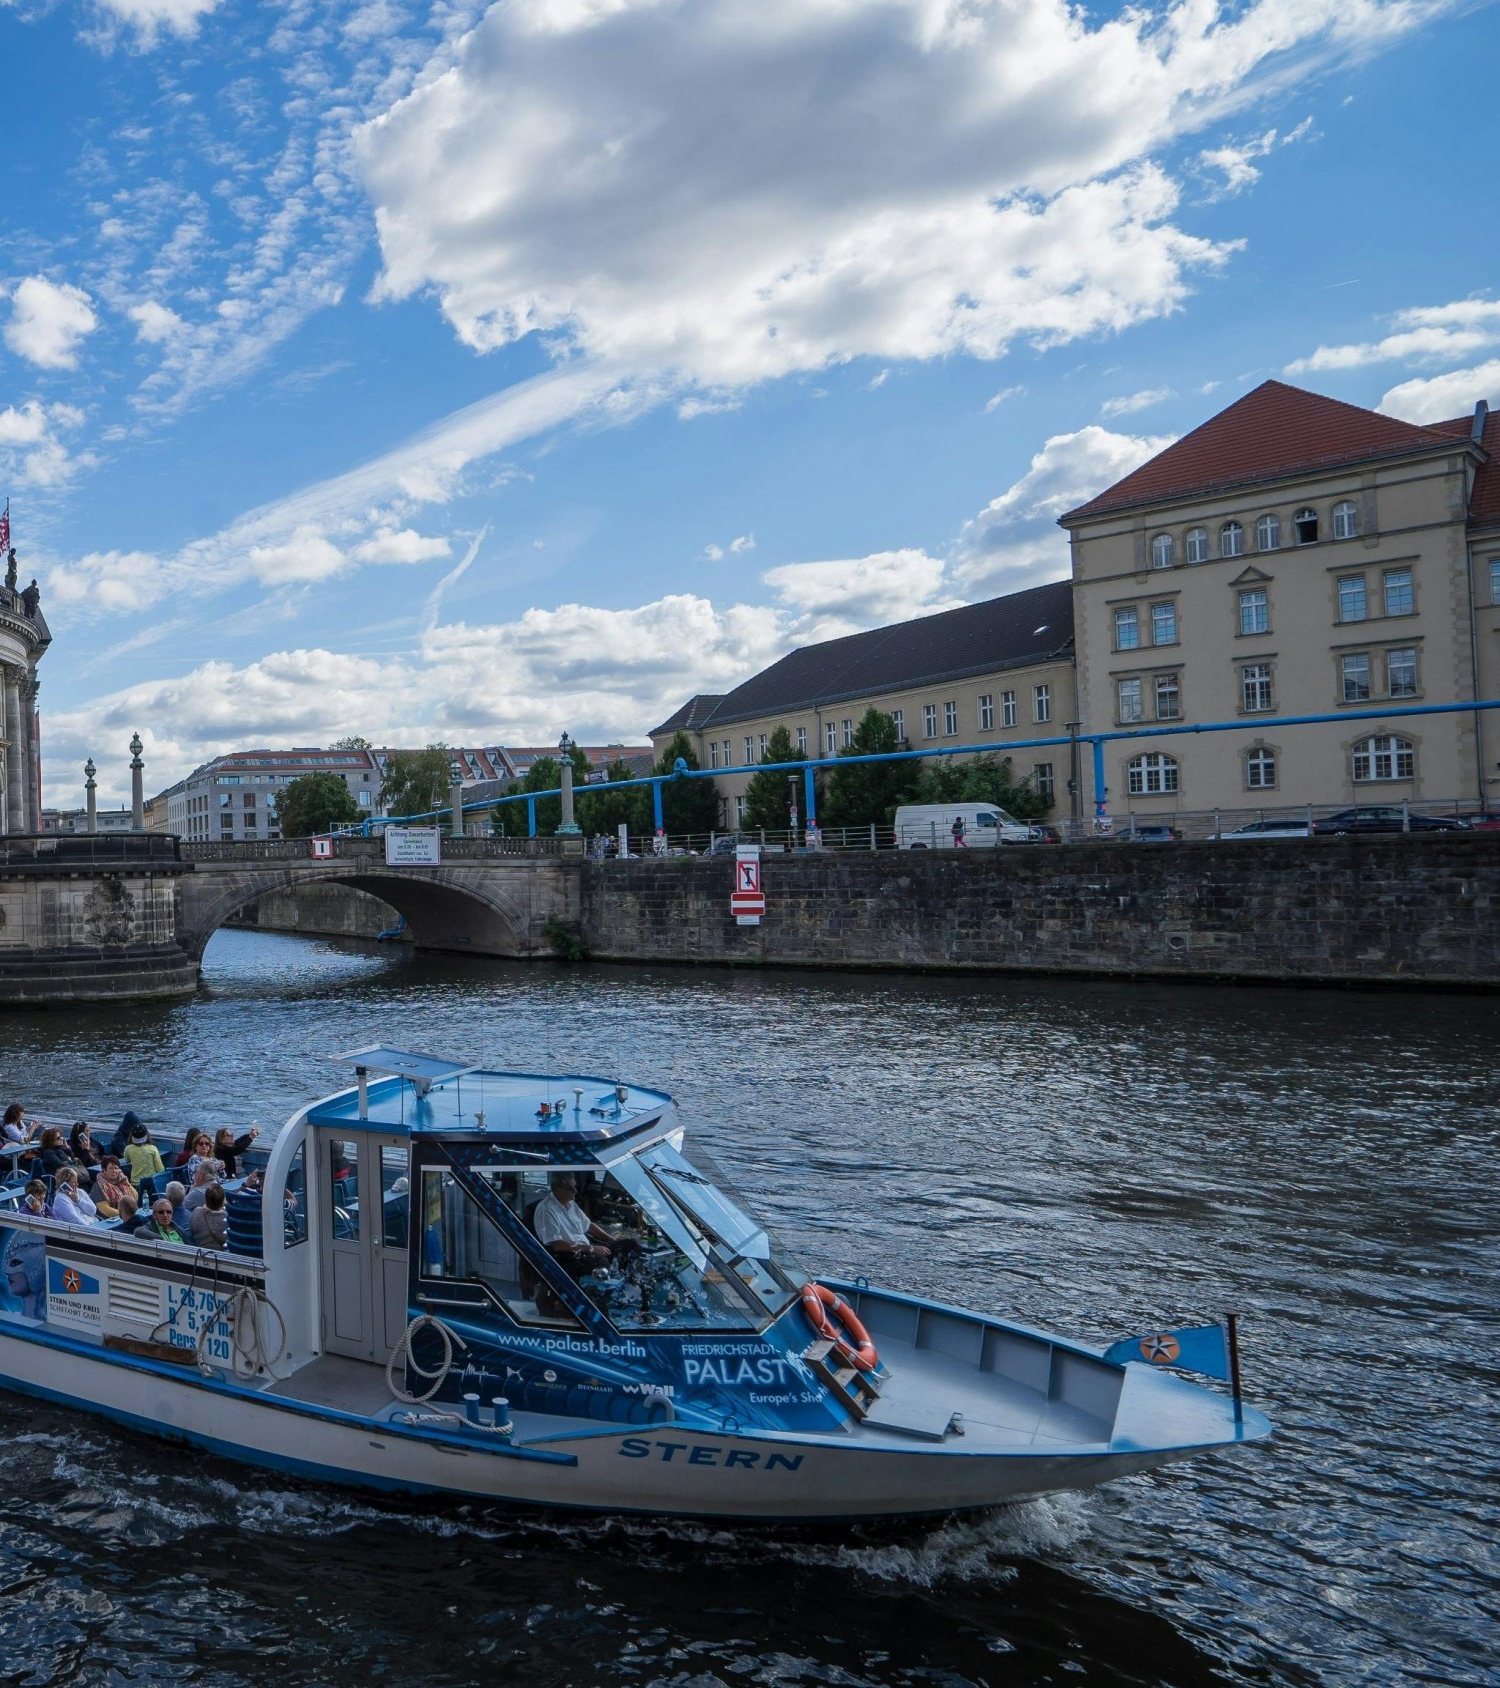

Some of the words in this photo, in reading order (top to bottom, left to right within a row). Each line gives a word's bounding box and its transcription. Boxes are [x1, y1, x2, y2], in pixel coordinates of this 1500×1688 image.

[168, 1285, 178, 1304] L.
[49, 1296, 68, 1306] STERN
[68, 1300, 81, 1309] UND
[83, 1304, 100, 1314] KREIS
[218, 1321, 229, 1338] m
[206, 1337, 229, 1360] 120
[498, 1334, 646, 1358] www.palast.berlin
[684, 1358, 788, 1385] PALAST
[639, 1382, 675, 1398] Wall
[750, 1391, 798, 1407] Europe's
[617, 1438, 805, 1471] STERN
